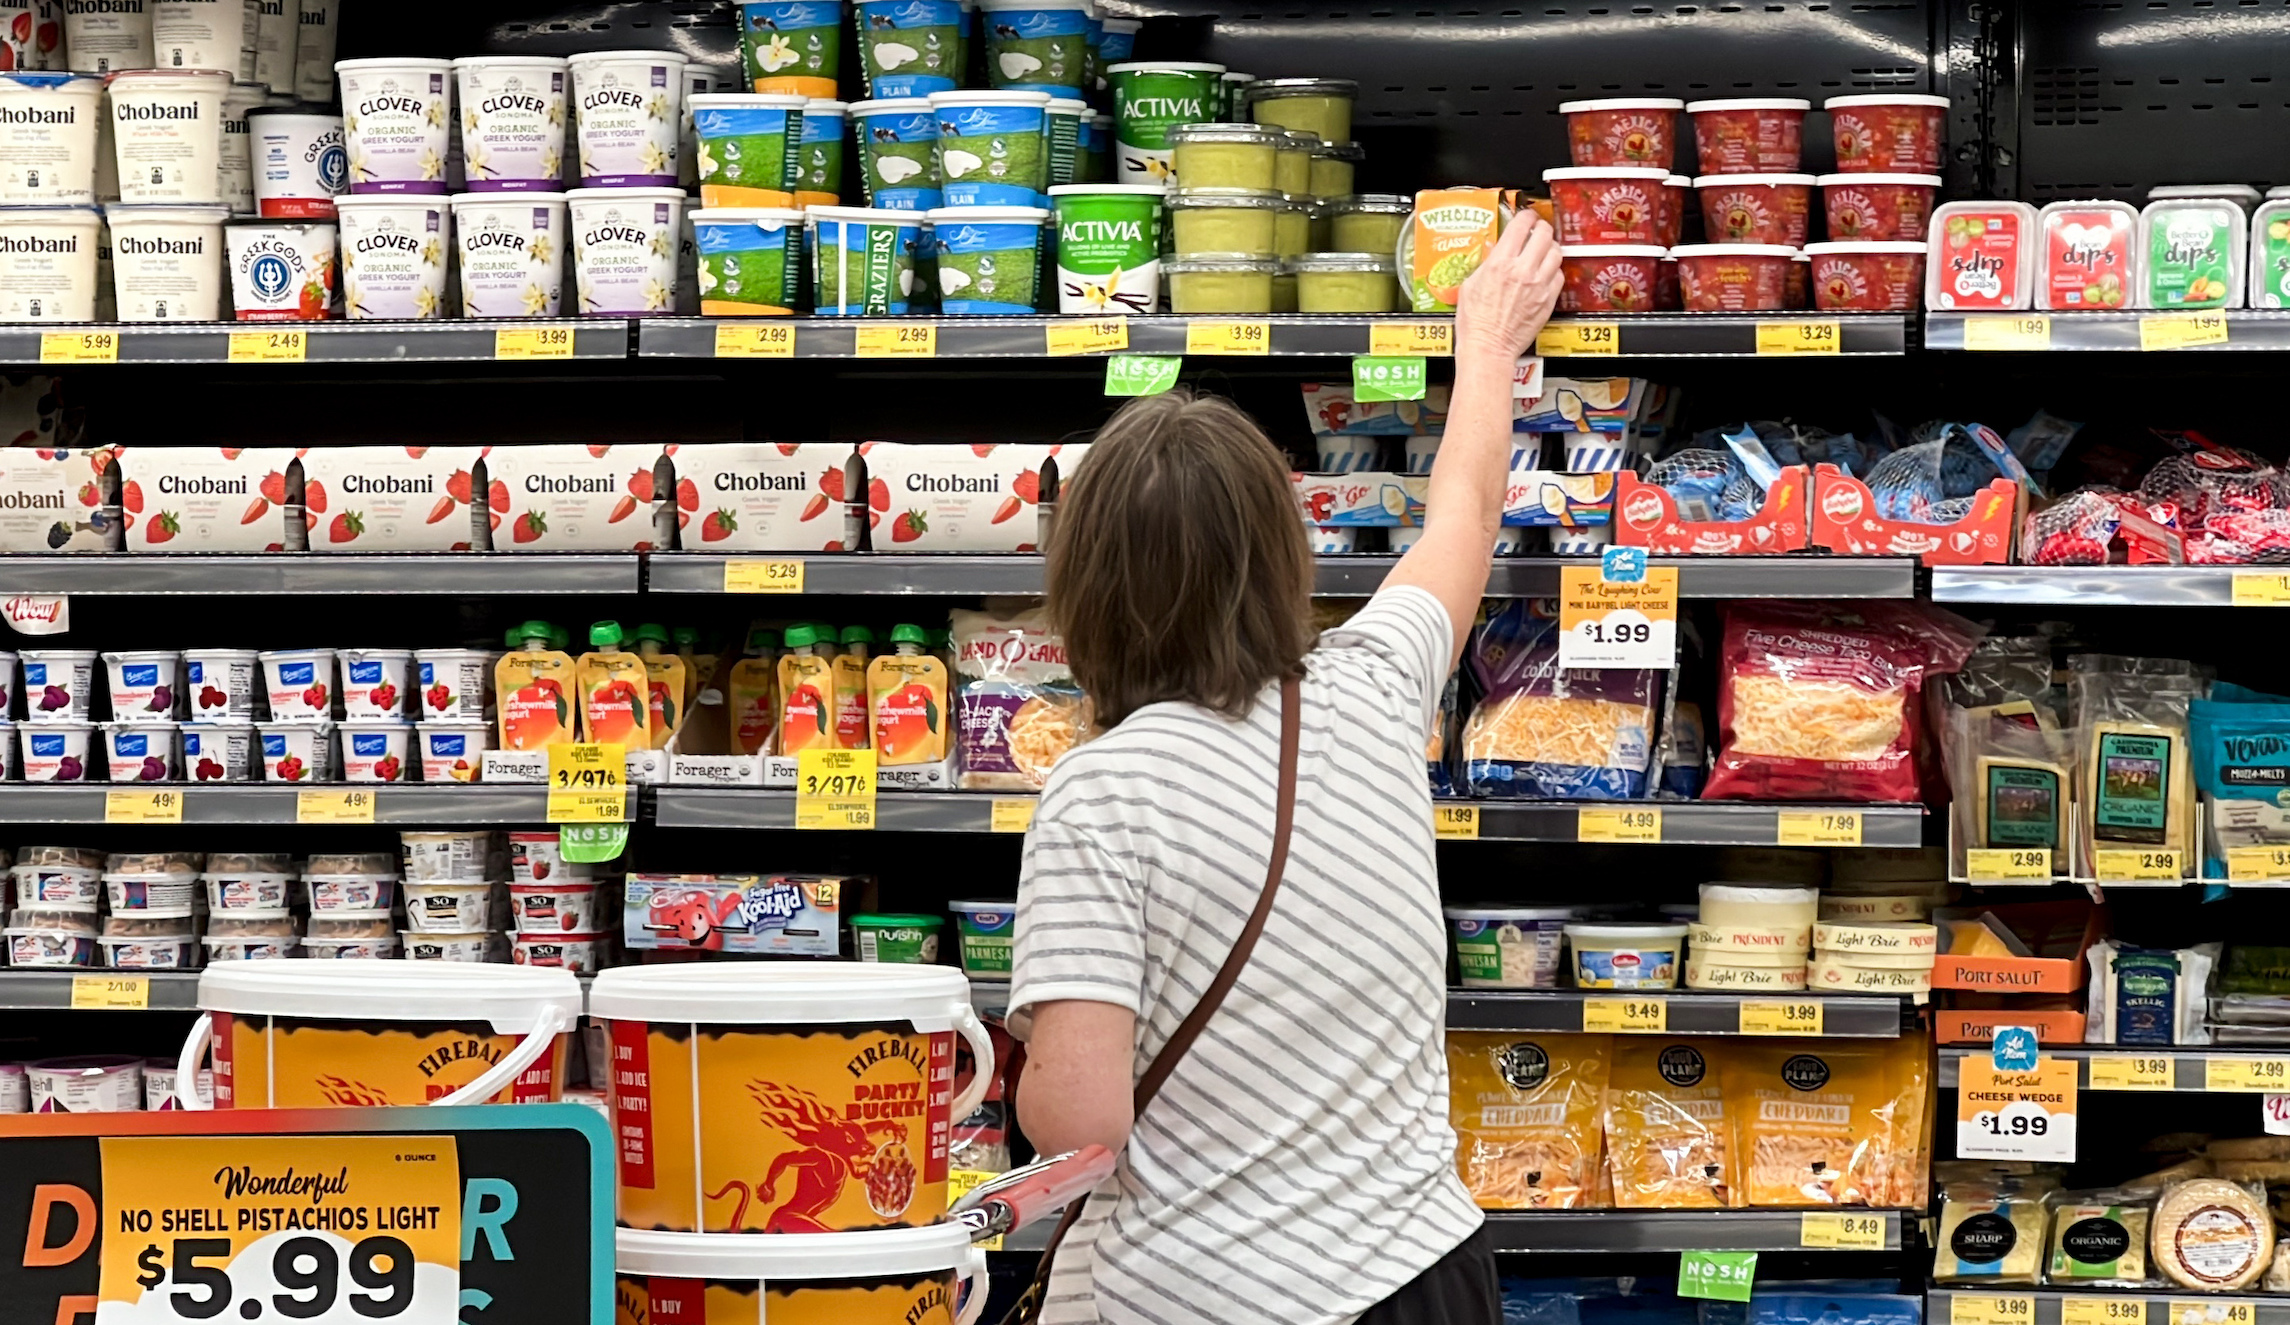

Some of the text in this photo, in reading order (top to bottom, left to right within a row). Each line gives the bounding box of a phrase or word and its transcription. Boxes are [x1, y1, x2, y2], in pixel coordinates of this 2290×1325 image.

[360, 96, 422, 117] CLOVER
[482, 94, 545, 115] CLOVER
[584, 89, 643, 110] CLOVER
[117, 100, 199, 121] Chobani
[1123, 98, 1202, 119] ACTIVIA
[367, 125, 416, 135] ORGANIC
[489, 124, 539, 134] ORGANIC
[590, 119, 637, 129] ORGANIC
[362, 135, 424, 144] GREEK YOGURT
[483, 134, 546, 143] GREEK YOGURT
[584, 129, 645, 138] GREEK YOGURT
[951, 194, 975, 206] PLAIN
[1424, 209, 1492, 225] WHOLLY
[585, 227, 646, 247] CLOVER
[1061, 221, 1142, 242] ACTIVIA
[119, 236, 203, 255] Chobani
[357, 234, 419, 254] CLOVER
[467, 232, 525, 252] CLOVER
[363, 262, 412, 273] ORGANIC
[472, 261, 518, 271] ORGANIC
[592, 256, 640, 266] ORGANIC
[358, 273, 421, 281] GREEK YOGURT
[468, 271, 527, 280] GREEK YOGURT
[586, 266, 648, 275] GREEK YOGURT
[867, 229, 895, 316] GRAZIERS
[159, 475, 247, 494] Chobani
[342, 475, 433, 493] Chobani
[525, 473, 615, 493] Chobani
[714, 471, 806, 491] Chobani
[906, 473, 999, 493] Chobani
[1598, 583, 1638, 597] Laughing
[1569, 601, 1669, 609] MINI BABYBEL LIGHT CHEESE
[1585, 623, 1650, 643] $1.99
[1800, 629, 1869, 648] SHREDDED
[960, 641, 996, 661] LAND
[1744, 629, 1775, 647] Five
[1778, 635, 1835, 655] Cheese
[1840, 646, 1871, 660] Taco
[488, 760, 541, 776] Forager
[675, 763, 730, 778] Forager
[558, 770, 617, 788] 3/97¢
[806, 775, 866, 795] 3/97¢
[152, 793, 175, 808] 49¢
[344, 793, 367, 807] 49¢
[2102, 802, 2160, 815] ORGANIC
[750, 886, 771, 898] Sugar
[818, 885, 832, 900] 12
[432, 896, 449, 905] SO
[531, 896, 548, 905] SO
[737, 886, 802, 924] Kool-Aid
[1699, 932, 1723, 944] Brie
[1836, 932, 1900, 948] Light Brie
[419, 946, 435, 955] SO
[537, 946, 554, 955] SO
[966, 947, 1012, 960] PARMESA
[1709, 970, 1772, 984] Light Brie
[1854, 973, 1915, 986] Light Brie
[1955, 967, 2041, 986] PORT SALUT
[2126, 997, 2166, 1008] SKELLIG
[1961, 1022, 1992, 1038] POR
[417, 1040, 502, 1079] FIREBAL
[619, 1046, 632, 1061] BUY
[847, 1039, 927, 1078] FIREBALL
[635, 1072, 647, 1087] ICE
[1992, 1075, 2014, 1087] Port
[854, 1082, 920, 1101] PARTY
[1968, 1091, 2063, 1103] CHEESE WEDGE
[846, 1100, 925, 1120] BUCKET
[1981, 1115, 2048, 1136] $1.99
[404, 1153, 437, 1162] OUNCE
[214, 1166, 348, 1203] Wonderful
[120, 1205, 441, 1233] NO SHELL PISTACHIOS LIGHT
[1964, 1234, 2003, 1244] SHARP
[2071, 1236, 2121, 1246] ORGANIC
[136, 1235, 416, 1321] $5.99
[652, 1299, 681, 1314] 1. BUY
